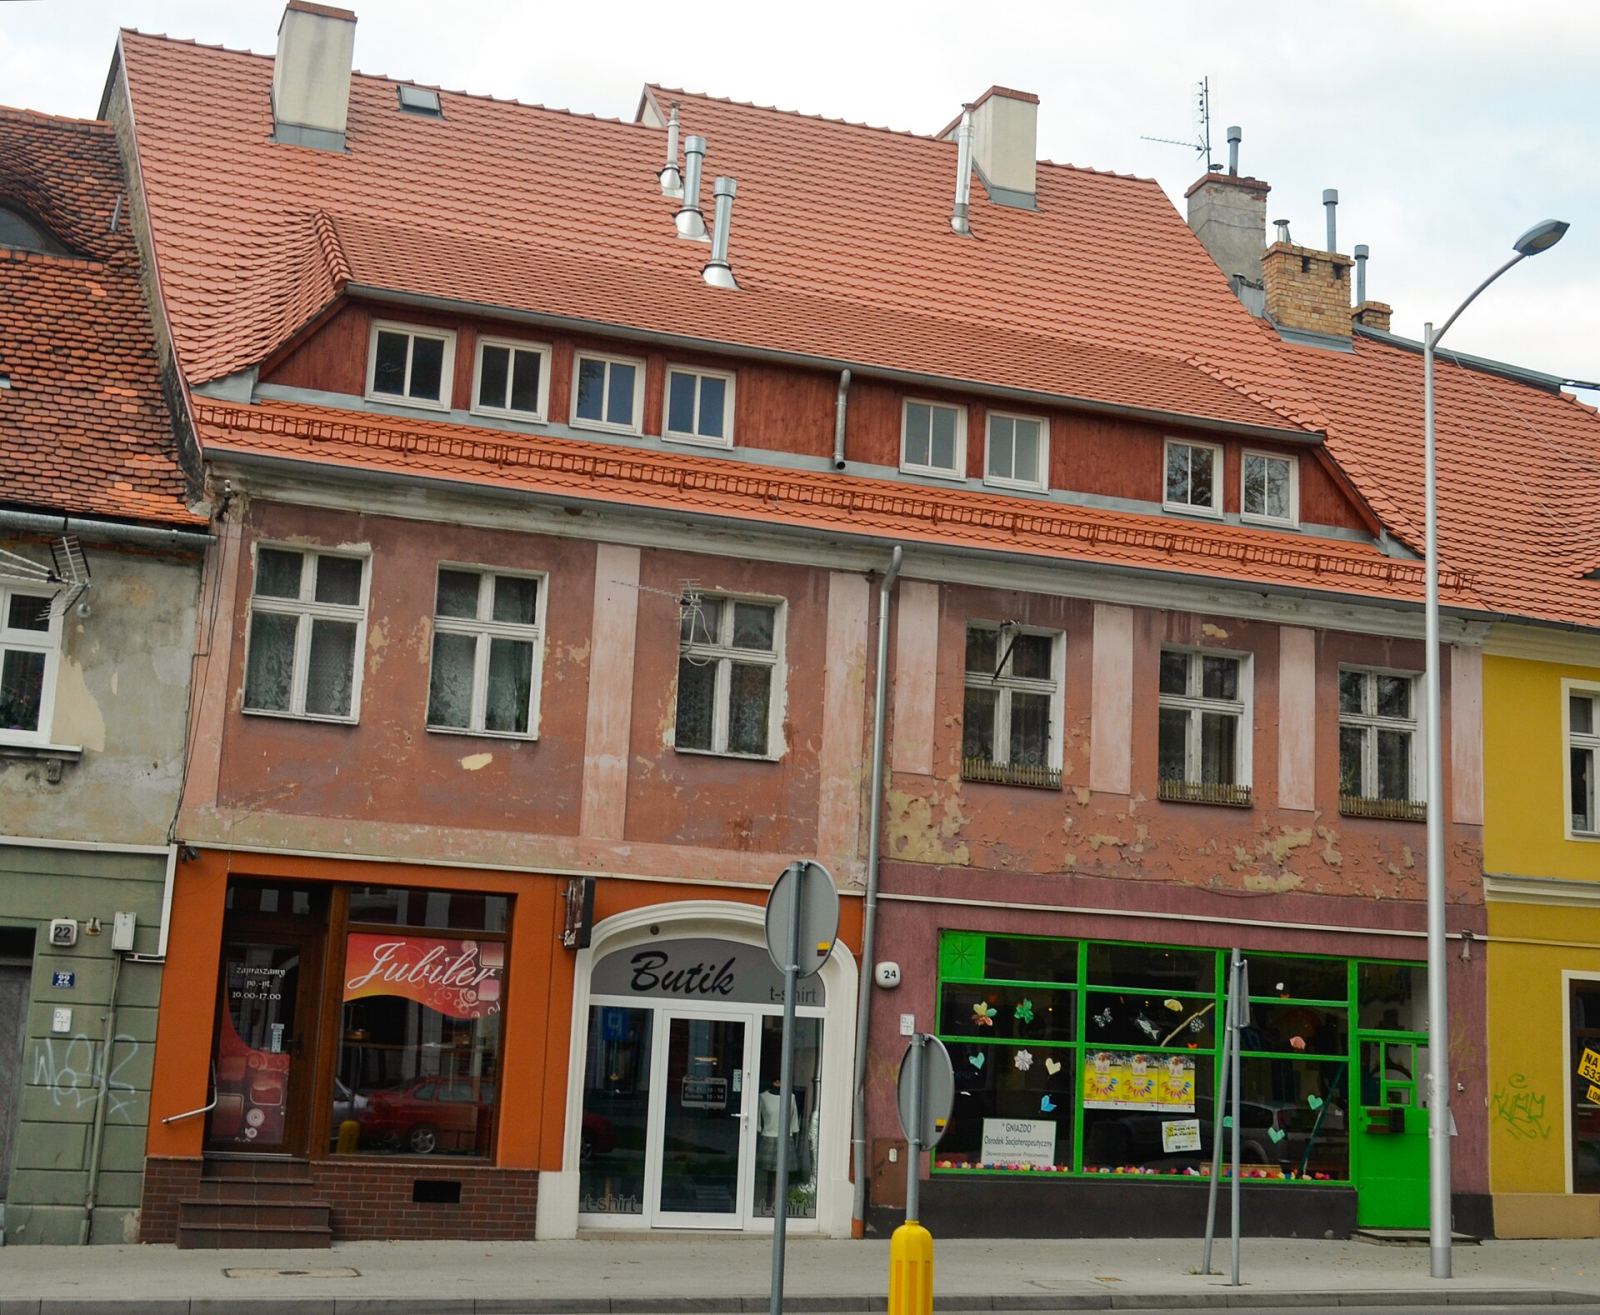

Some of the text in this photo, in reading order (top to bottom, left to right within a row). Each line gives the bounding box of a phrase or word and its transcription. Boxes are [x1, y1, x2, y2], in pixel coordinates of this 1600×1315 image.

[55, 926, 71, 937] 22
[347, 942, 496, 989] Jubiler
[630, 951, 736, 995] Butik
[58, 974, 70, 984] 22
[884, 970, 897, 979] 24
[1585, 1053, 1598, 1068] NA
[585, 1193, 637, 1211] t-shirt
